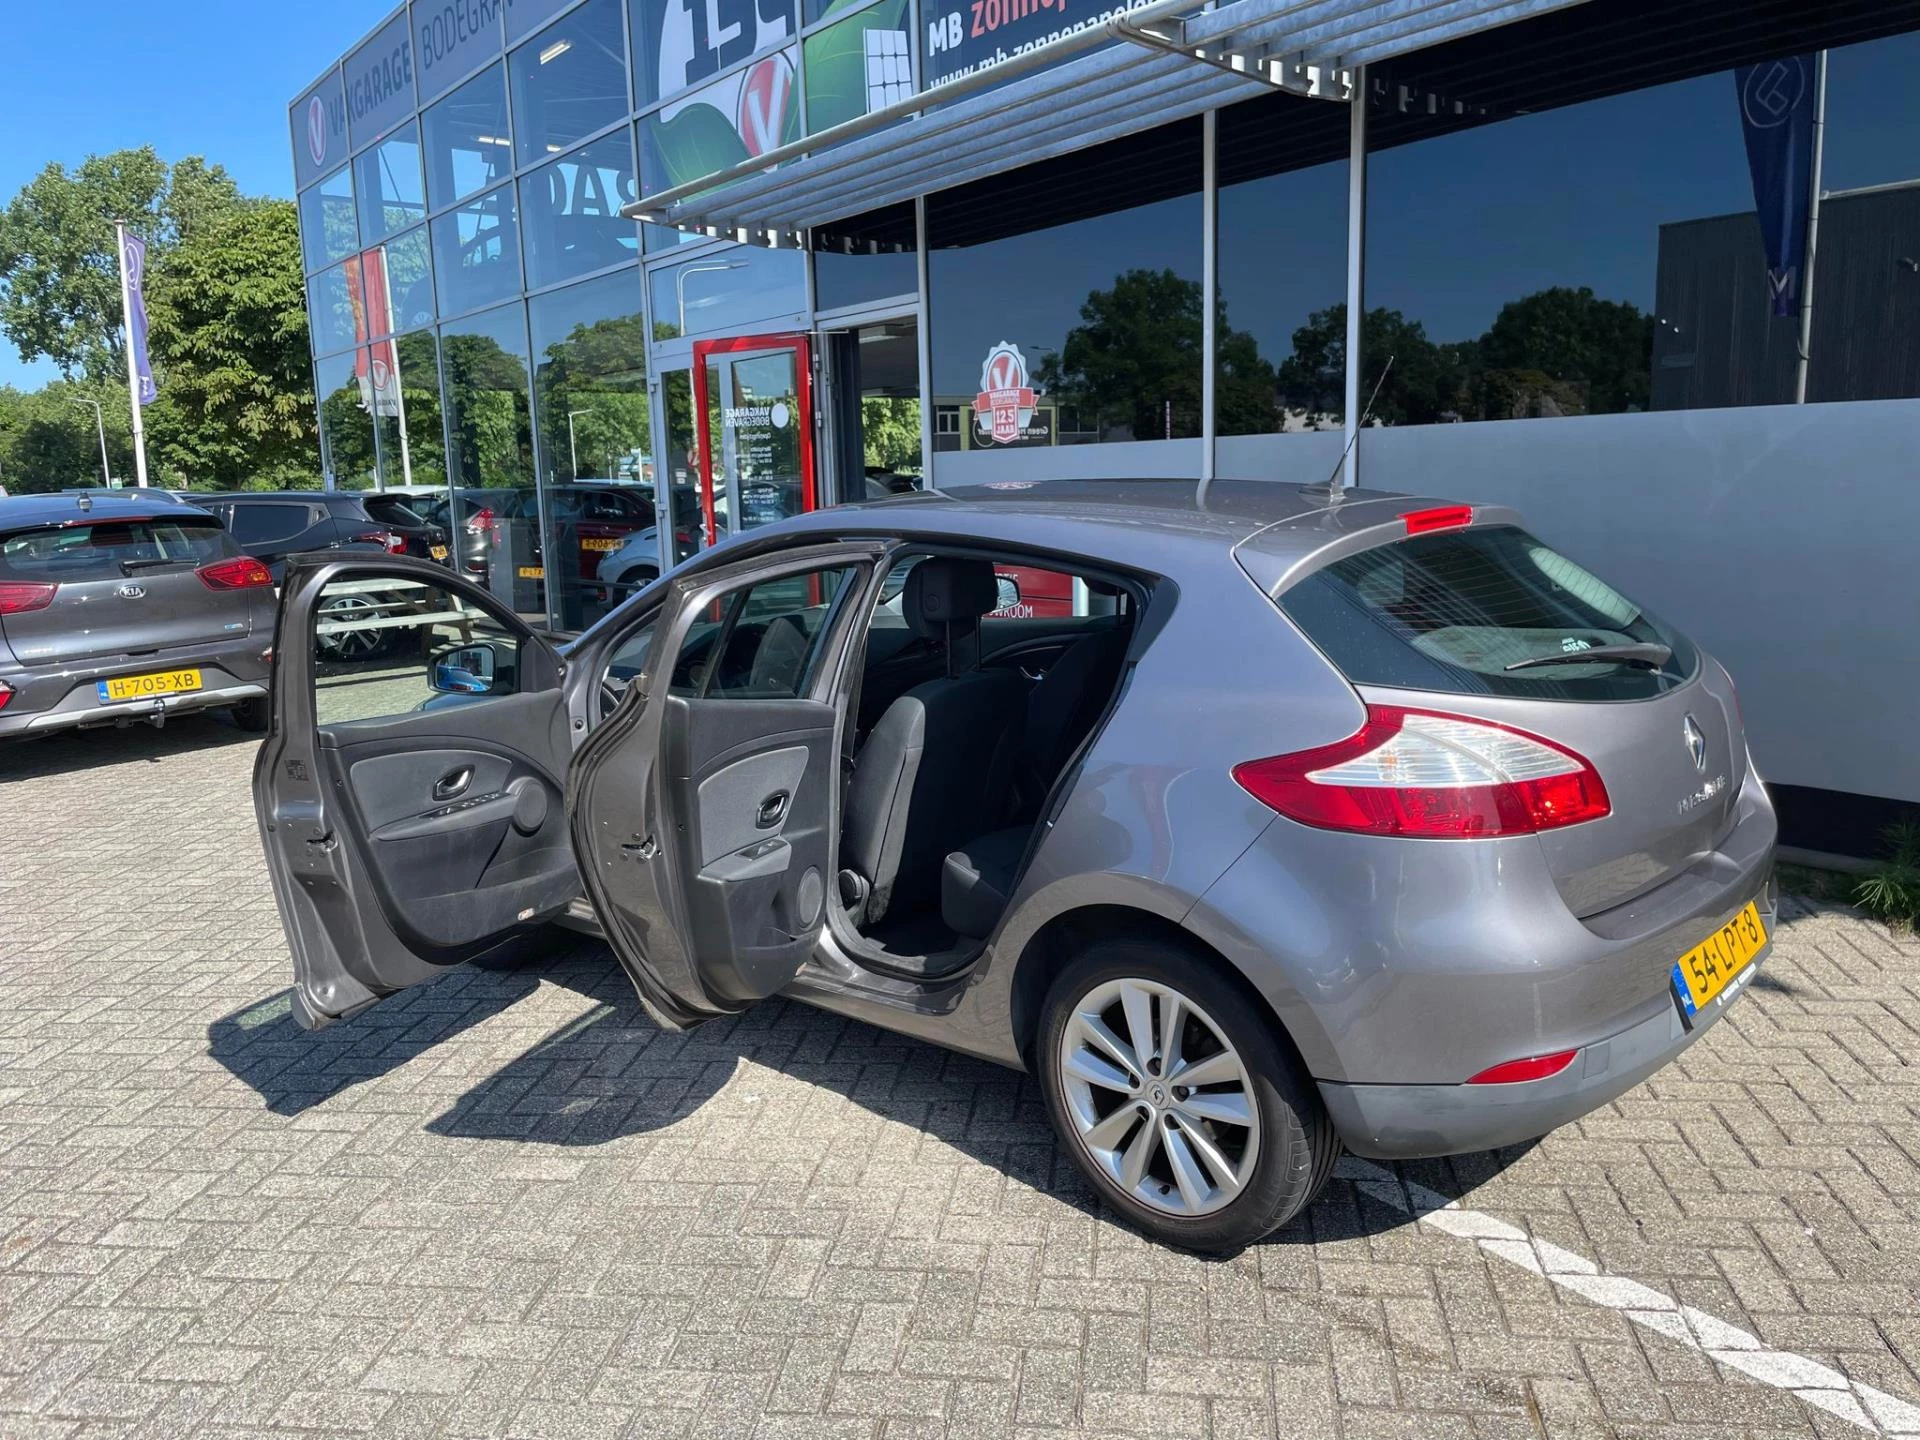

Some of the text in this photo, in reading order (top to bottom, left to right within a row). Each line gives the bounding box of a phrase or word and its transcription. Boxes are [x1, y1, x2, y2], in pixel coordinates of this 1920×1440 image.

[928, 11, 963, 56] MB
[996, 409, 1014, 424] 125
[124, 586, 142, 597] KIA
[113, 674, 194, 697] H-705-XB
[1689, 909, 1758, 994] 54-LPT-8
